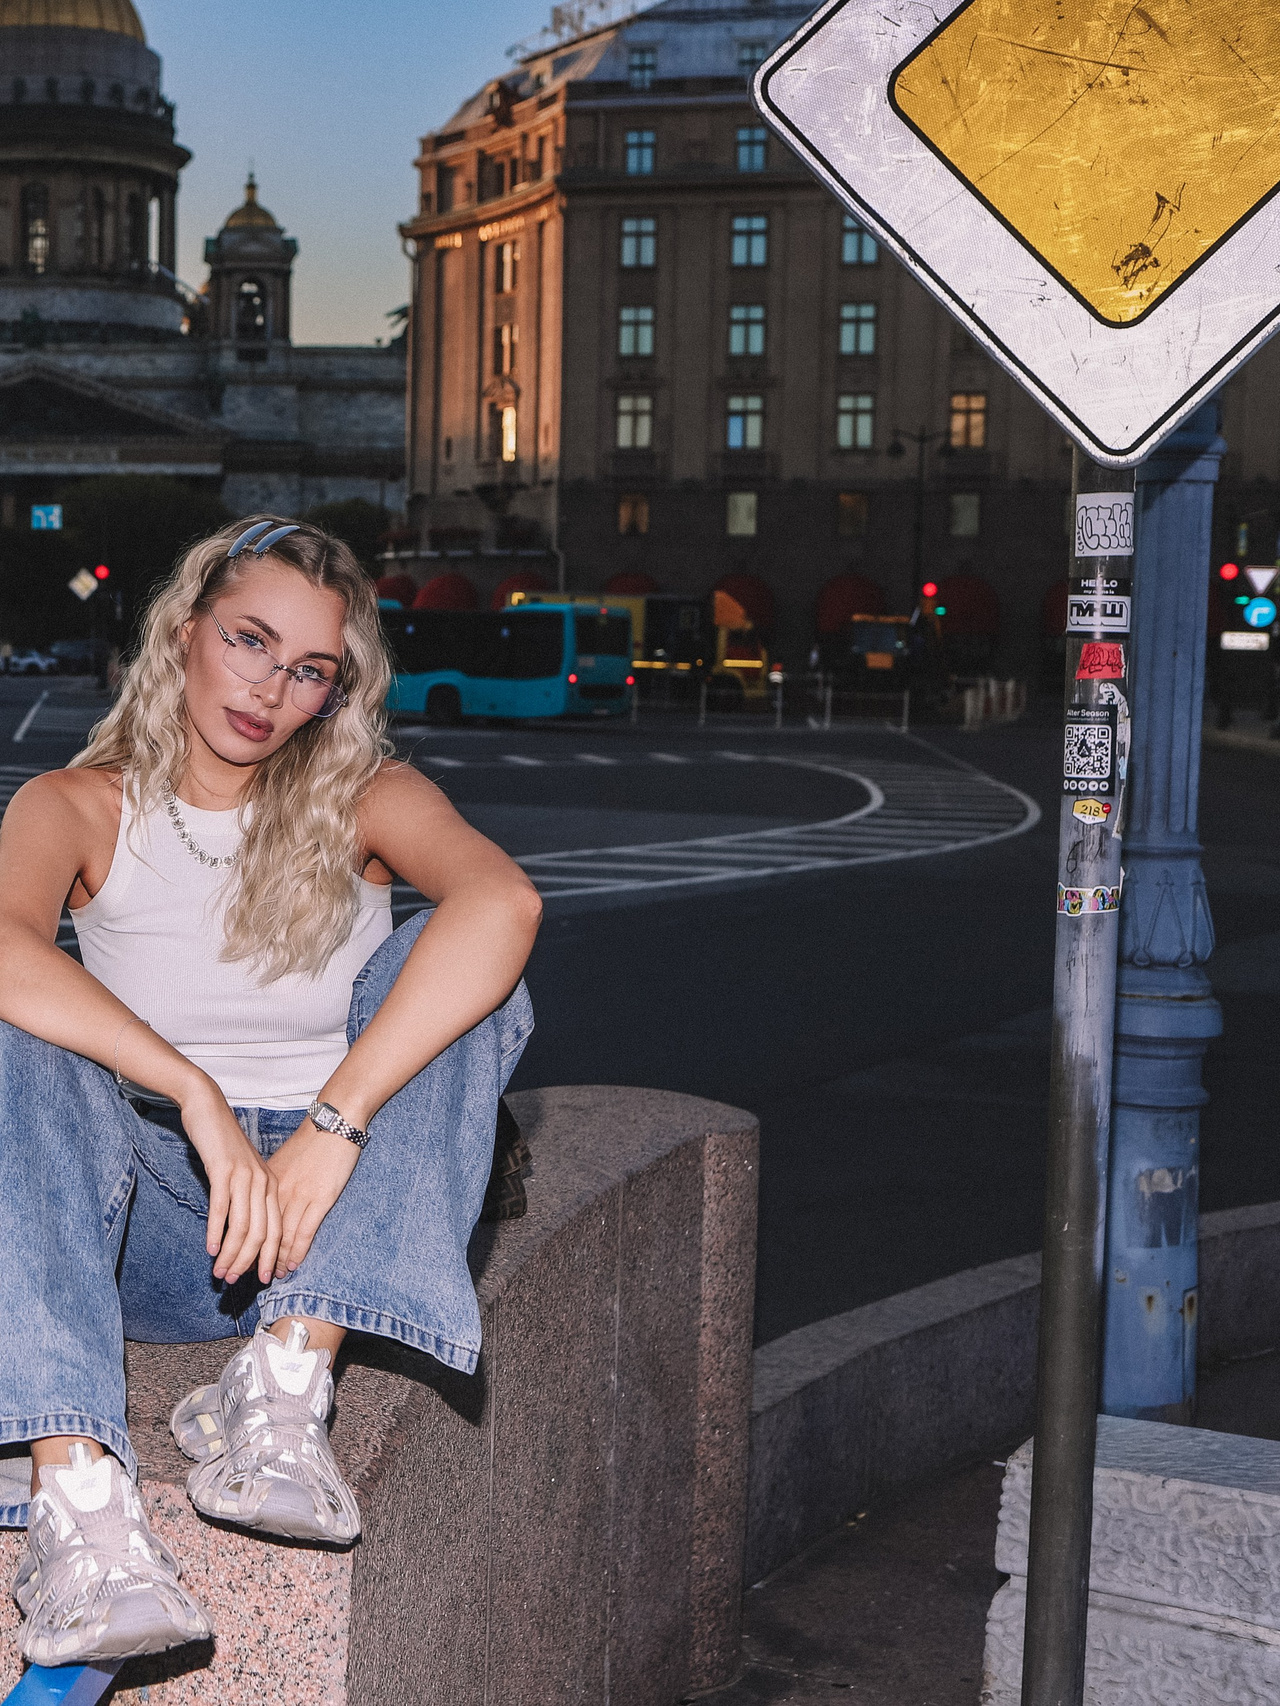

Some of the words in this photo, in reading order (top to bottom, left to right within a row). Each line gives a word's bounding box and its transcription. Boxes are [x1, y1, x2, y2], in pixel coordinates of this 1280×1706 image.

[1081, 579, 1118, 588] HELLO
[1081, 708, 1110, 717] Season
[1080, 804, 1101, 817] 218
